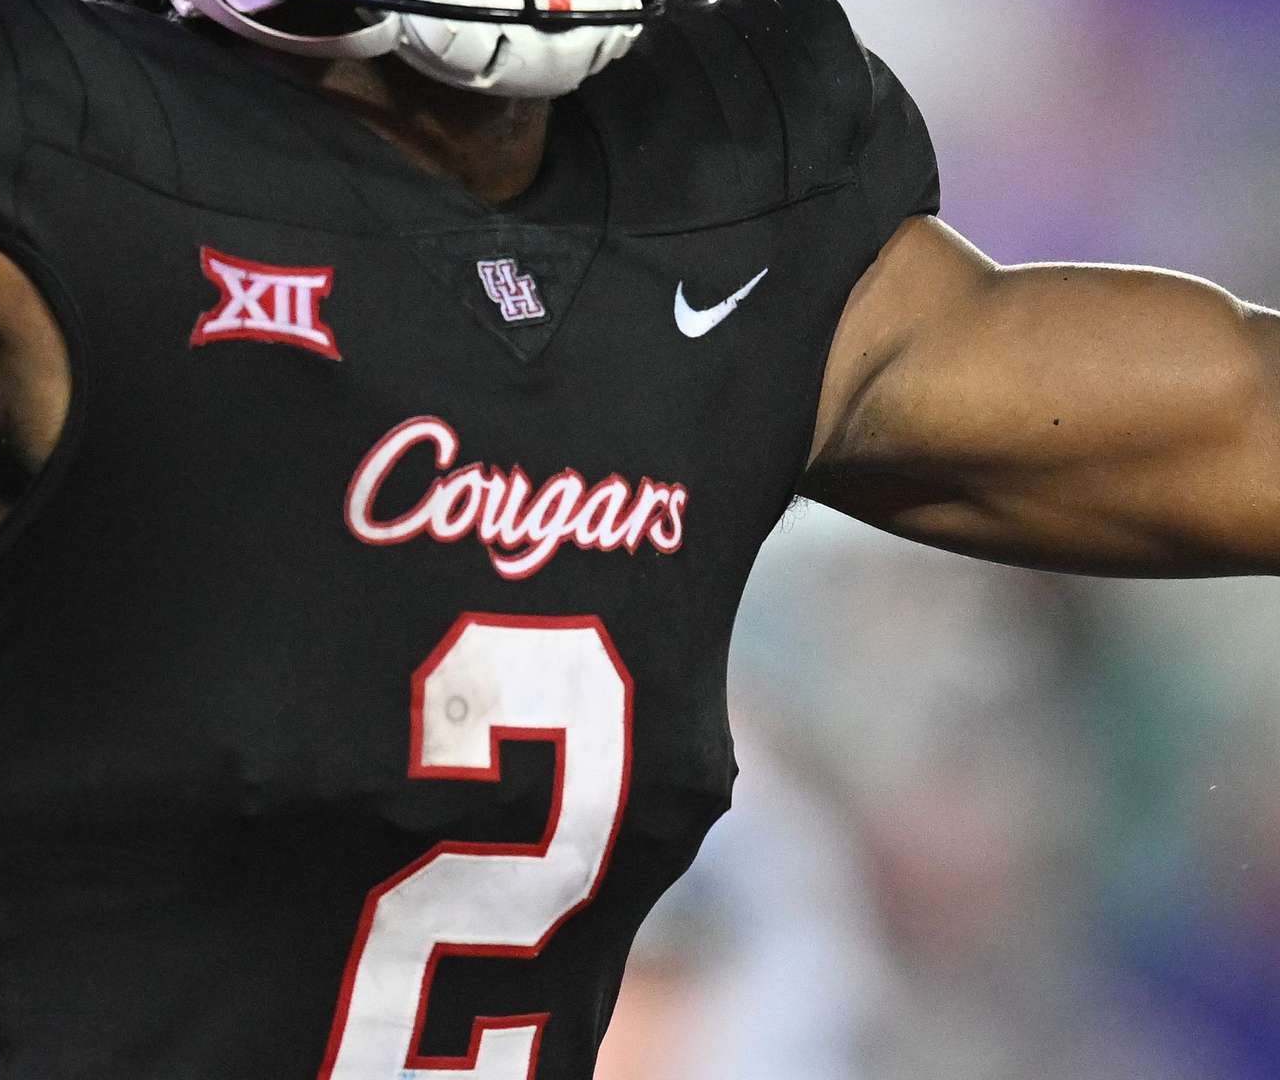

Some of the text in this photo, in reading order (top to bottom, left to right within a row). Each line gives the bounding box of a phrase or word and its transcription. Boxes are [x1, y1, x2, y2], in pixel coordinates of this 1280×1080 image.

[208, 258, 329, 346] XII
[344, 415, 688, 580] Cougars
[318, 611, 634, 1080] 2
